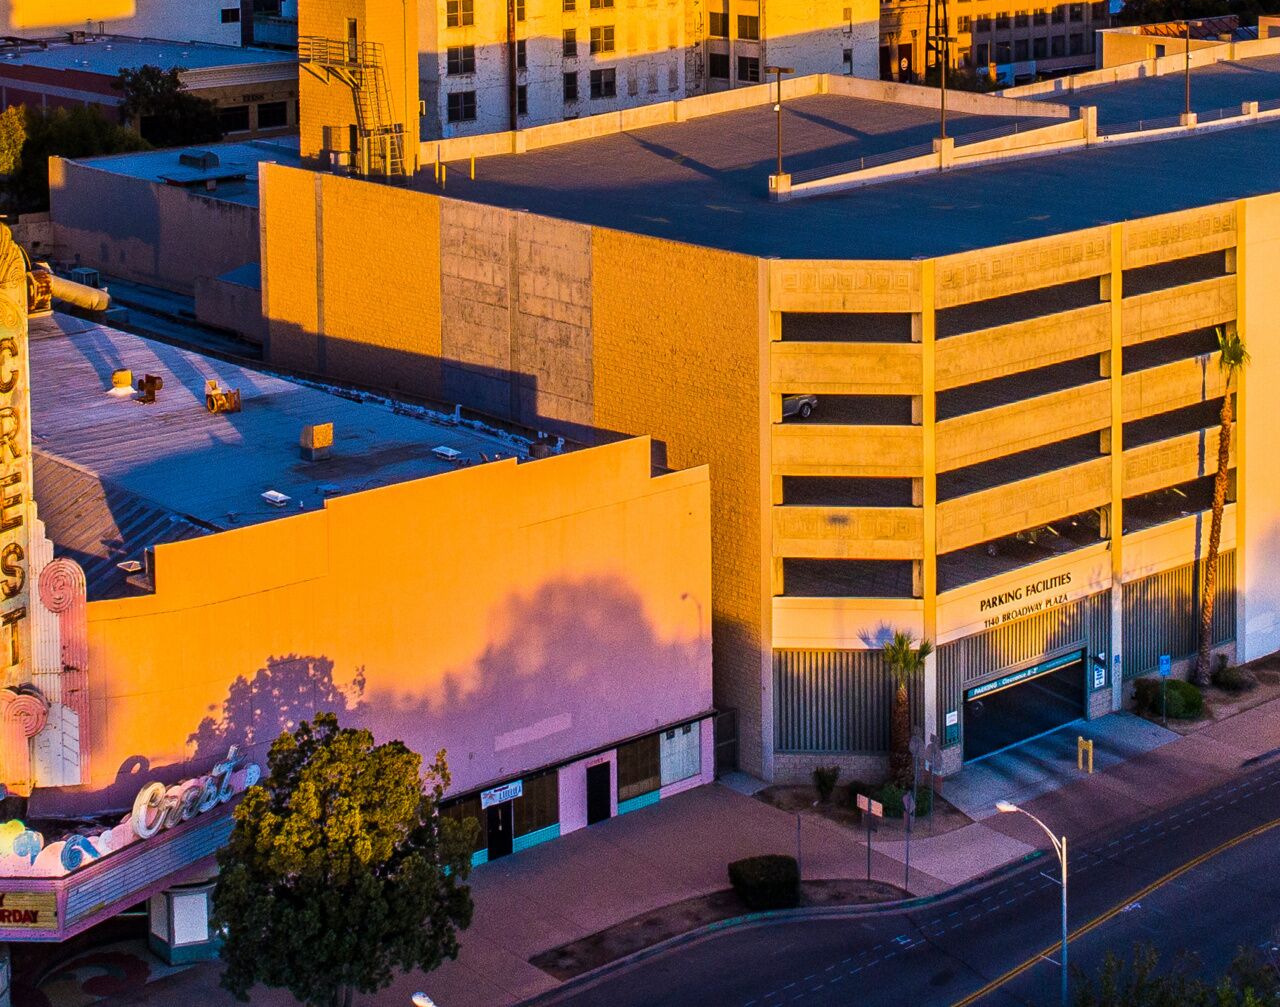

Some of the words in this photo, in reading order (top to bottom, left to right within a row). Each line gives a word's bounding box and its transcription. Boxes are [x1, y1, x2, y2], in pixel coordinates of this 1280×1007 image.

[980, 587, 1023, 612] PARKING
[1025, 572, 1072, 597] FACILITIES
[984, 616, 1000, 629] 1140
[1002, 602, 1043, 623] BROADWAY
[1045, 593, 1068, 608] PLAZA
